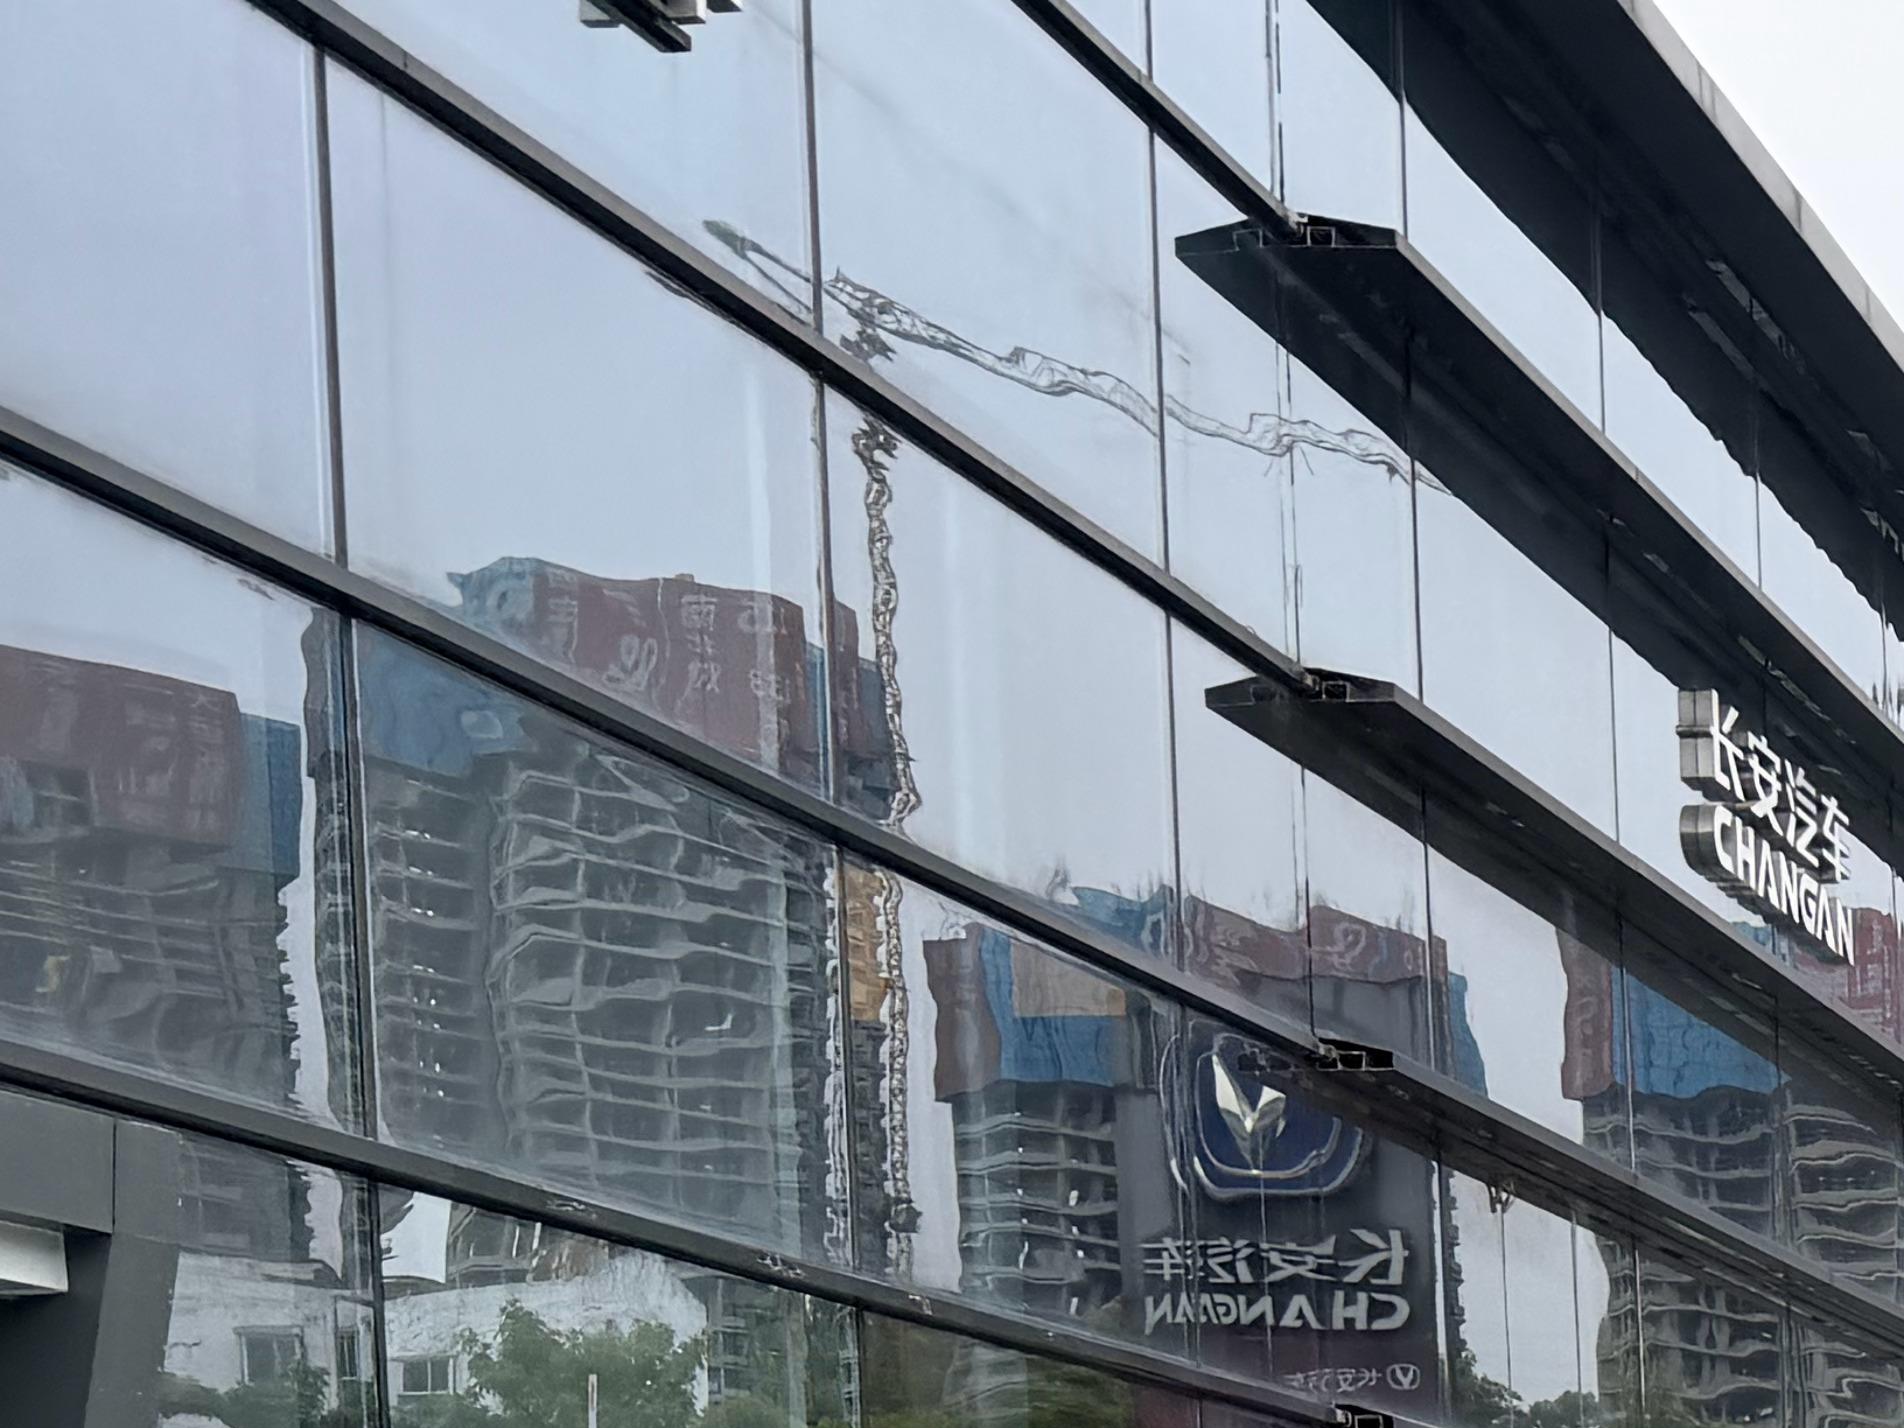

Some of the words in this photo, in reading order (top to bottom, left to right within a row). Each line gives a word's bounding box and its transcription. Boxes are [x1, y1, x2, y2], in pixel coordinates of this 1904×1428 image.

[1709, 688, 1850, 882] 长安汽车
[1712, 804, 1856, 968] CHANGAN
